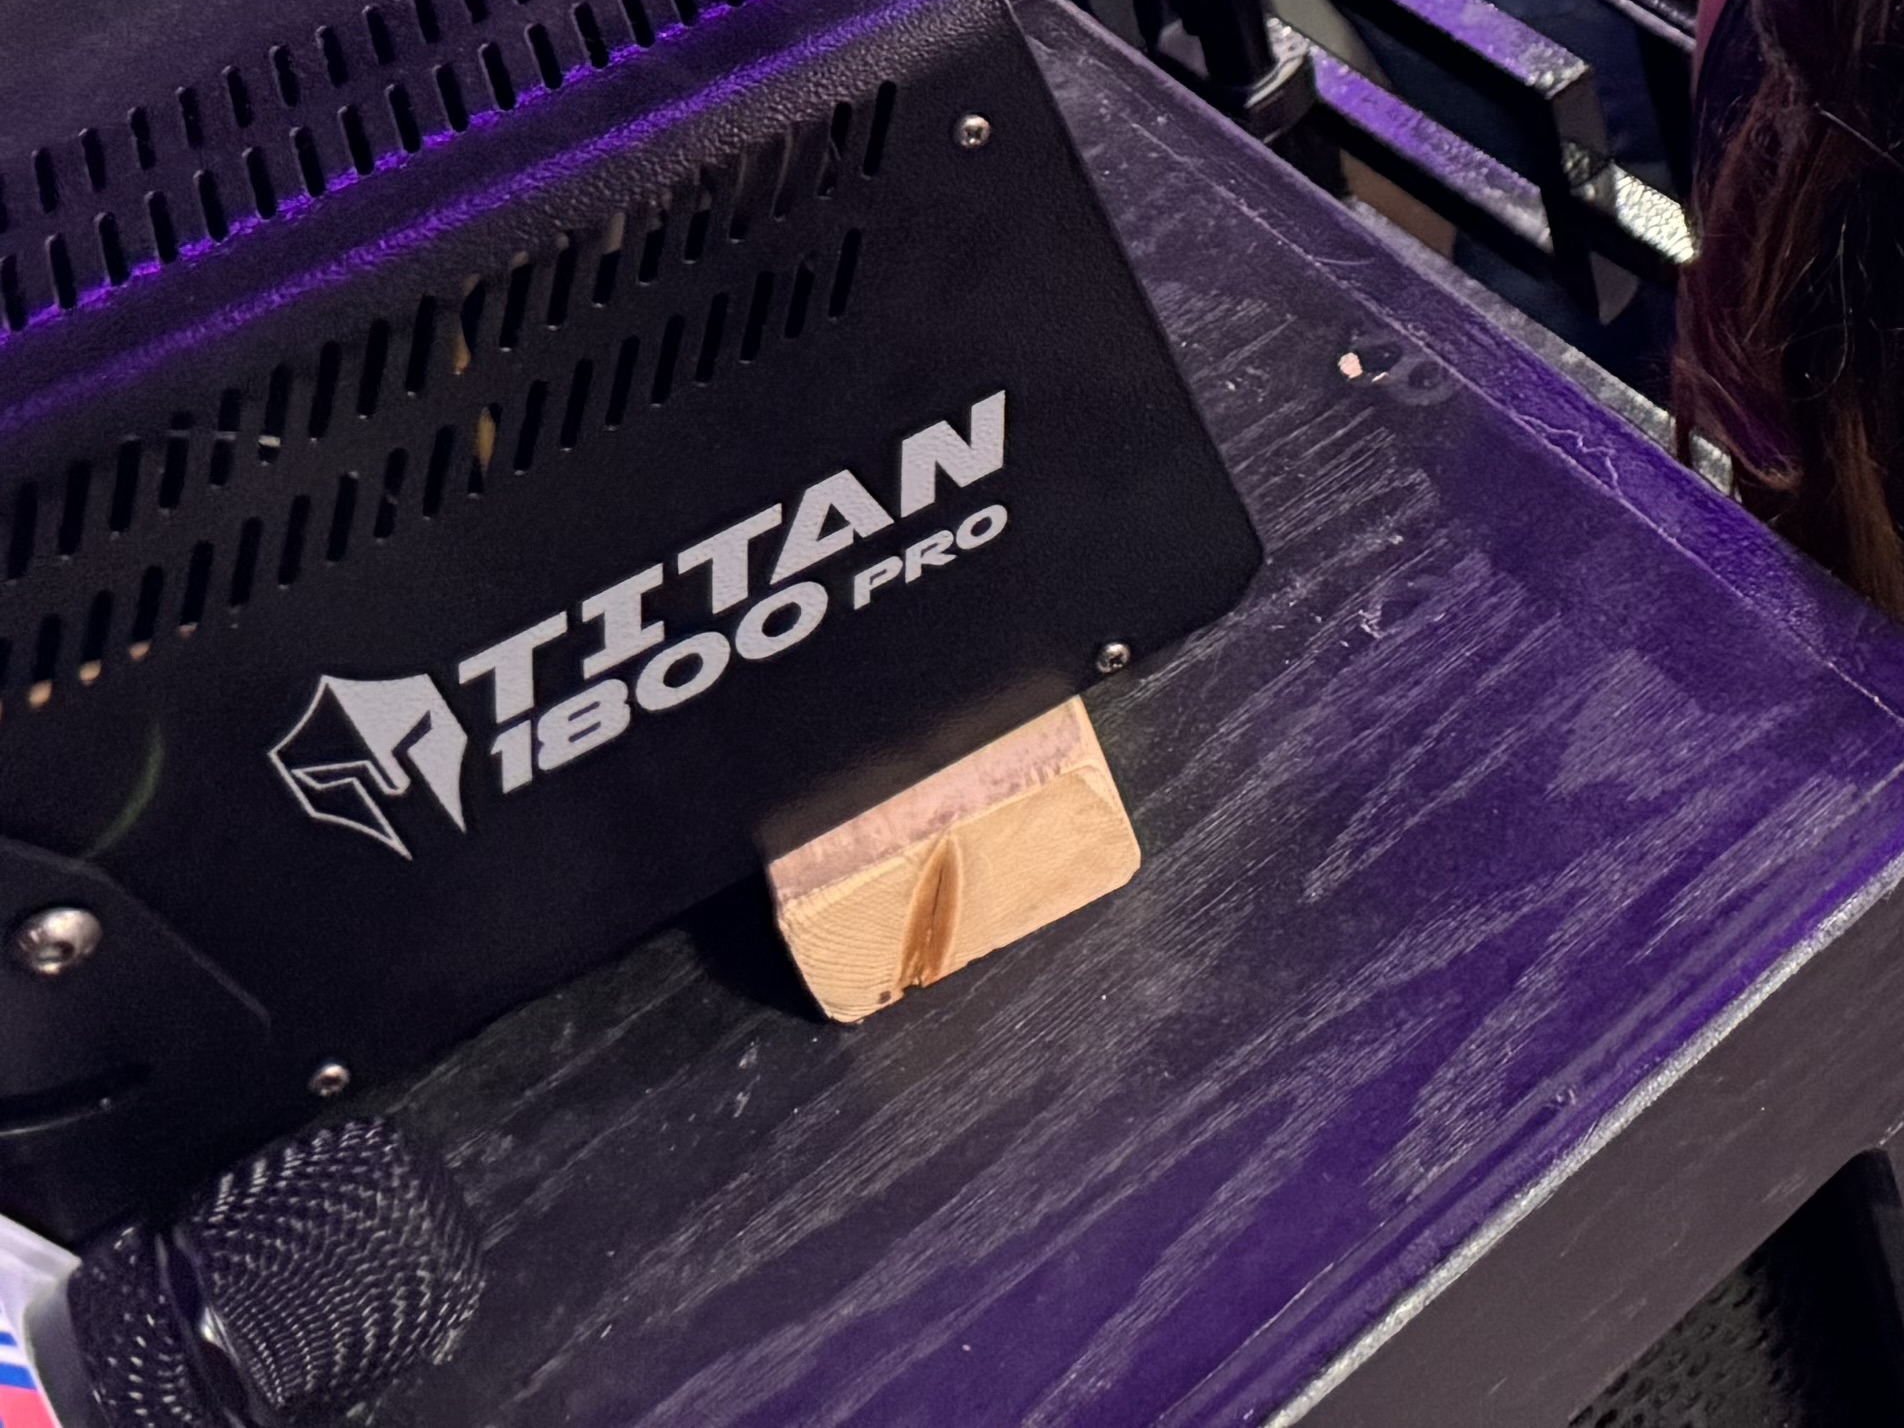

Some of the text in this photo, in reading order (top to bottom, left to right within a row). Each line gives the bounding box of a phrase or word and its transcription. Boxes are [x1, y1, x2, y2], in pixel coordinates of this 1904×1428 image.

[458, 390, 1005, 726] TITAN
[490, 504, 1008, 793] 1800 PRO
